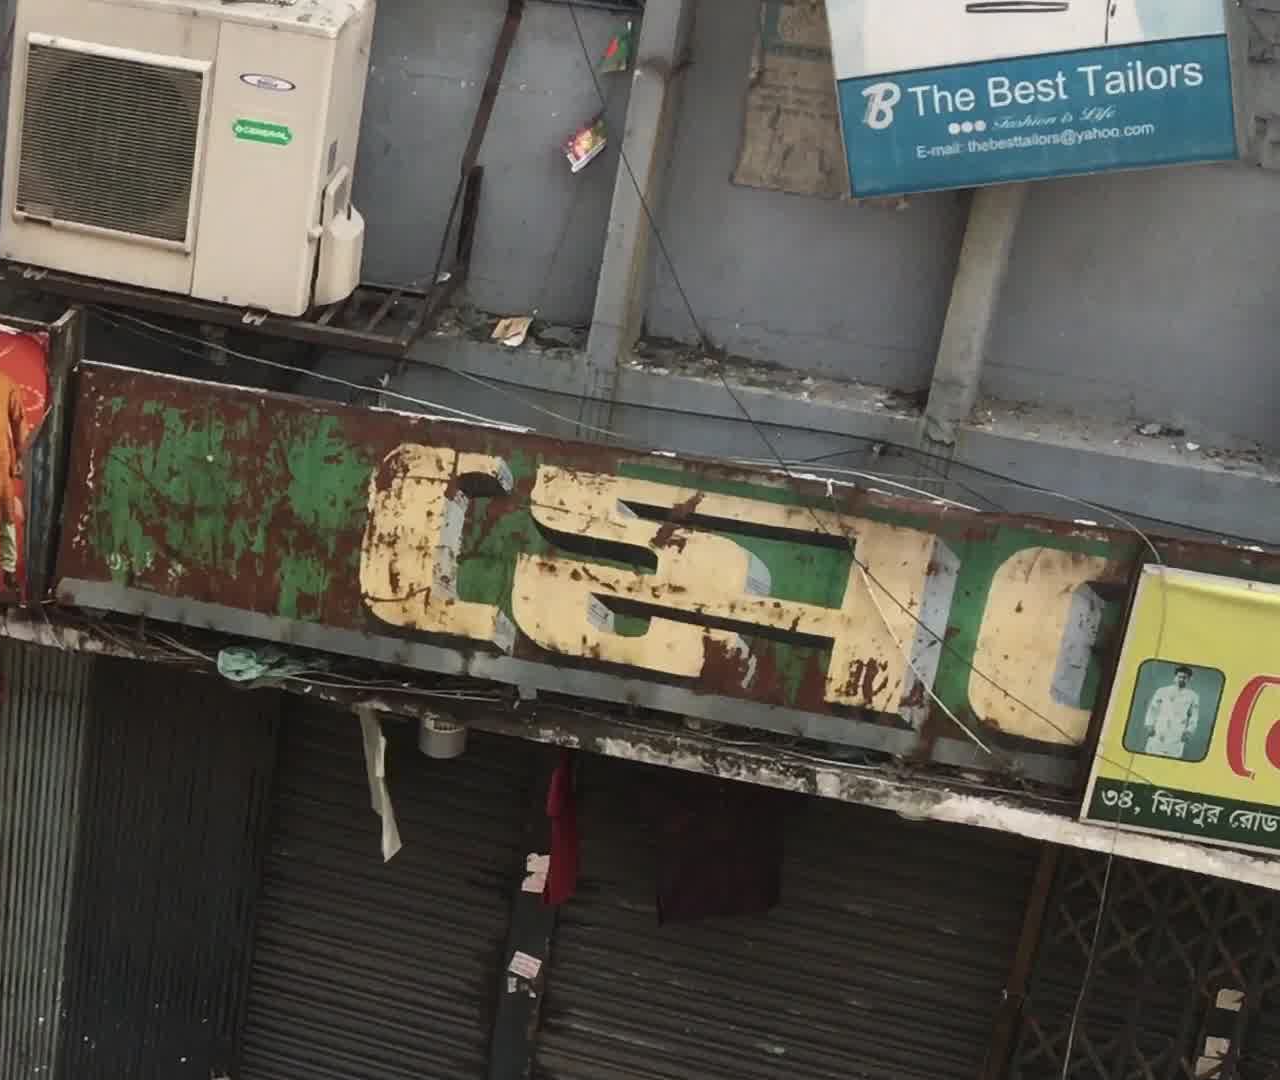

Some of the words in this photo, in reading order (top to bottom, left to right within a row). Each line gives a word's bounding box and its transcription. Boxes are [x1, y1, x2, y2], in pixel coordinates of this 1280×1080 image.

[908, 84, 976, 117] The
[987, 70, 1069, 109] Best
[1077, 60, 1205, 97] Tailors
[967, 123, 1155, 154] thebesttailors@yahoo.com
[1100, 789, 1141, 816] ৩৪,
[1151, 790, 1223, 829] মিরপুর
